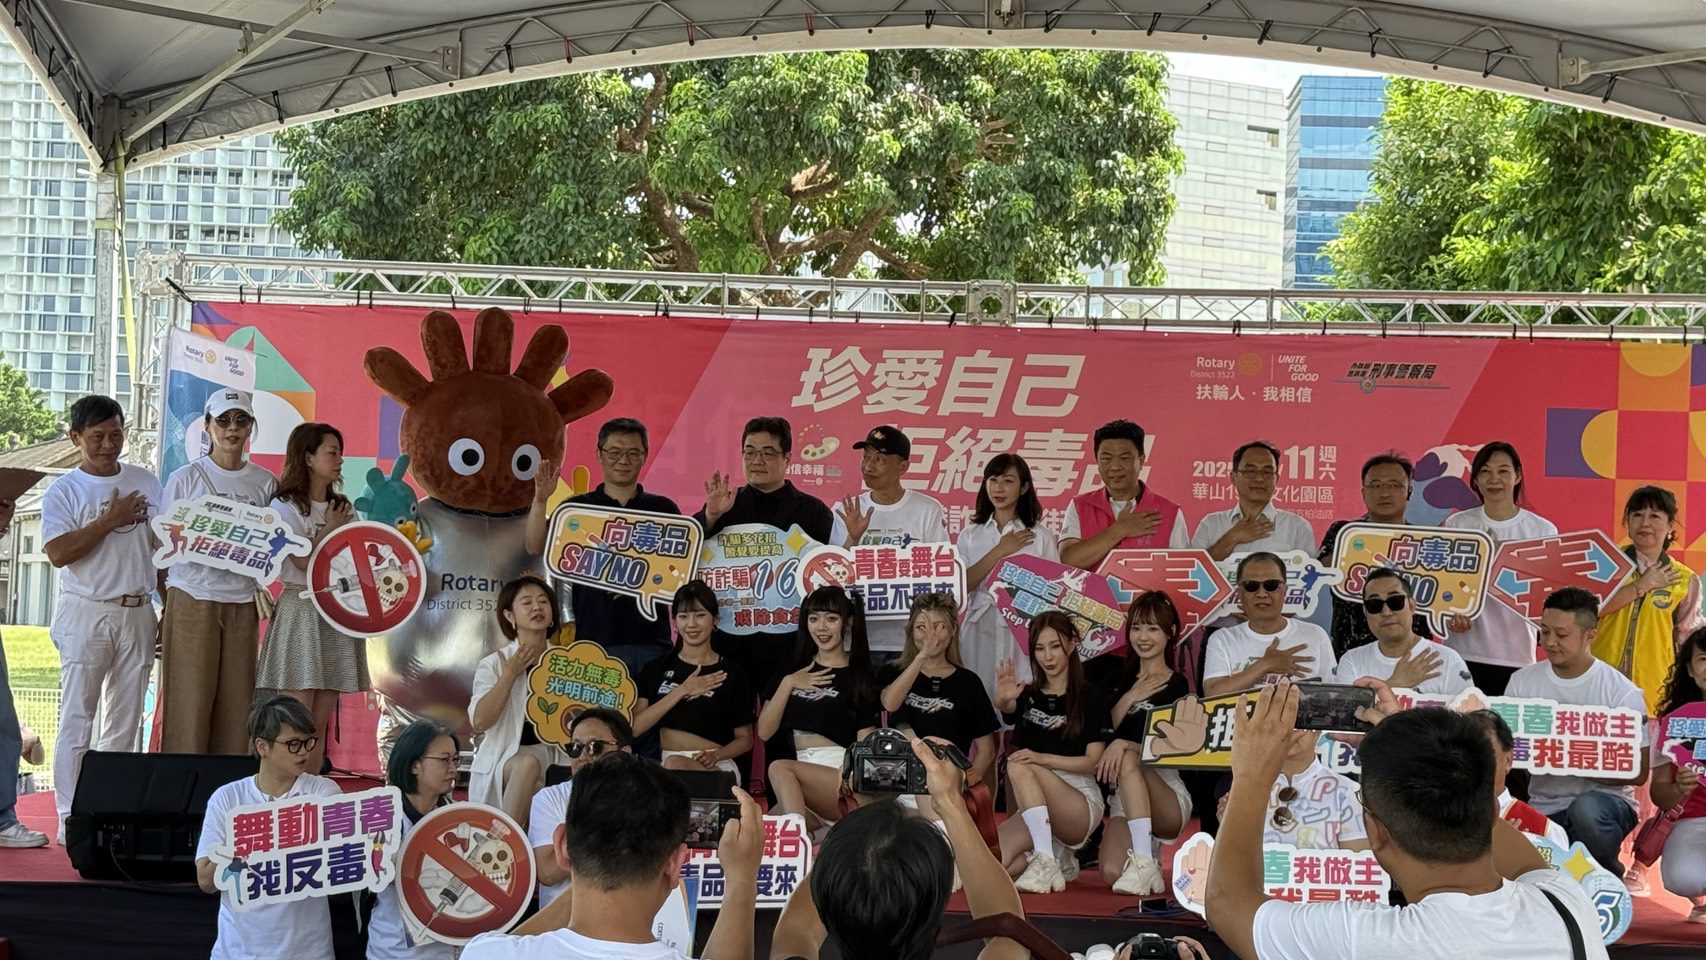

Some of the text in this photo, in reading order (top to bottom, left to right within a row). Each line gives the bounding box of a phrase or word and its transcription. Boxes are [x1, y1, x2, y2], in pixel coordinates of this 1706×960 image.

[1190, 370, 1235, 379] District 3522
[1196, 356, 1235, 370] Rotary
[1278, 355, 1306, 364] UNITE
[1288, 364, 1308, 373] FOR
[1291, 373, 1319, 381] GOOD
[791, 346, 1086, 417] 珍愛自己
[861, 424, 1155, 495] 絕毒
[187, 514, 271, 548] 珍愛自己
[602, 517, 692, 558] 向毒品
[189, 535, 270, 570] 拒絕毒品
[560, 543, 649, 588] SAY NO
[855, 545, 955, 579] 青春要舞台
[1389, 535, 1481, 573] 向毒品
[997, 561, 1064, 603] 珍愛自己
[426, 599, 471, 611] District
[1001, 607, 1024, 627] Step
[549, 653, 622, 688] 活力無毒
[233, 795, 394, 858] 舞動青春
[247, 842, 367, 900] 我反毒
